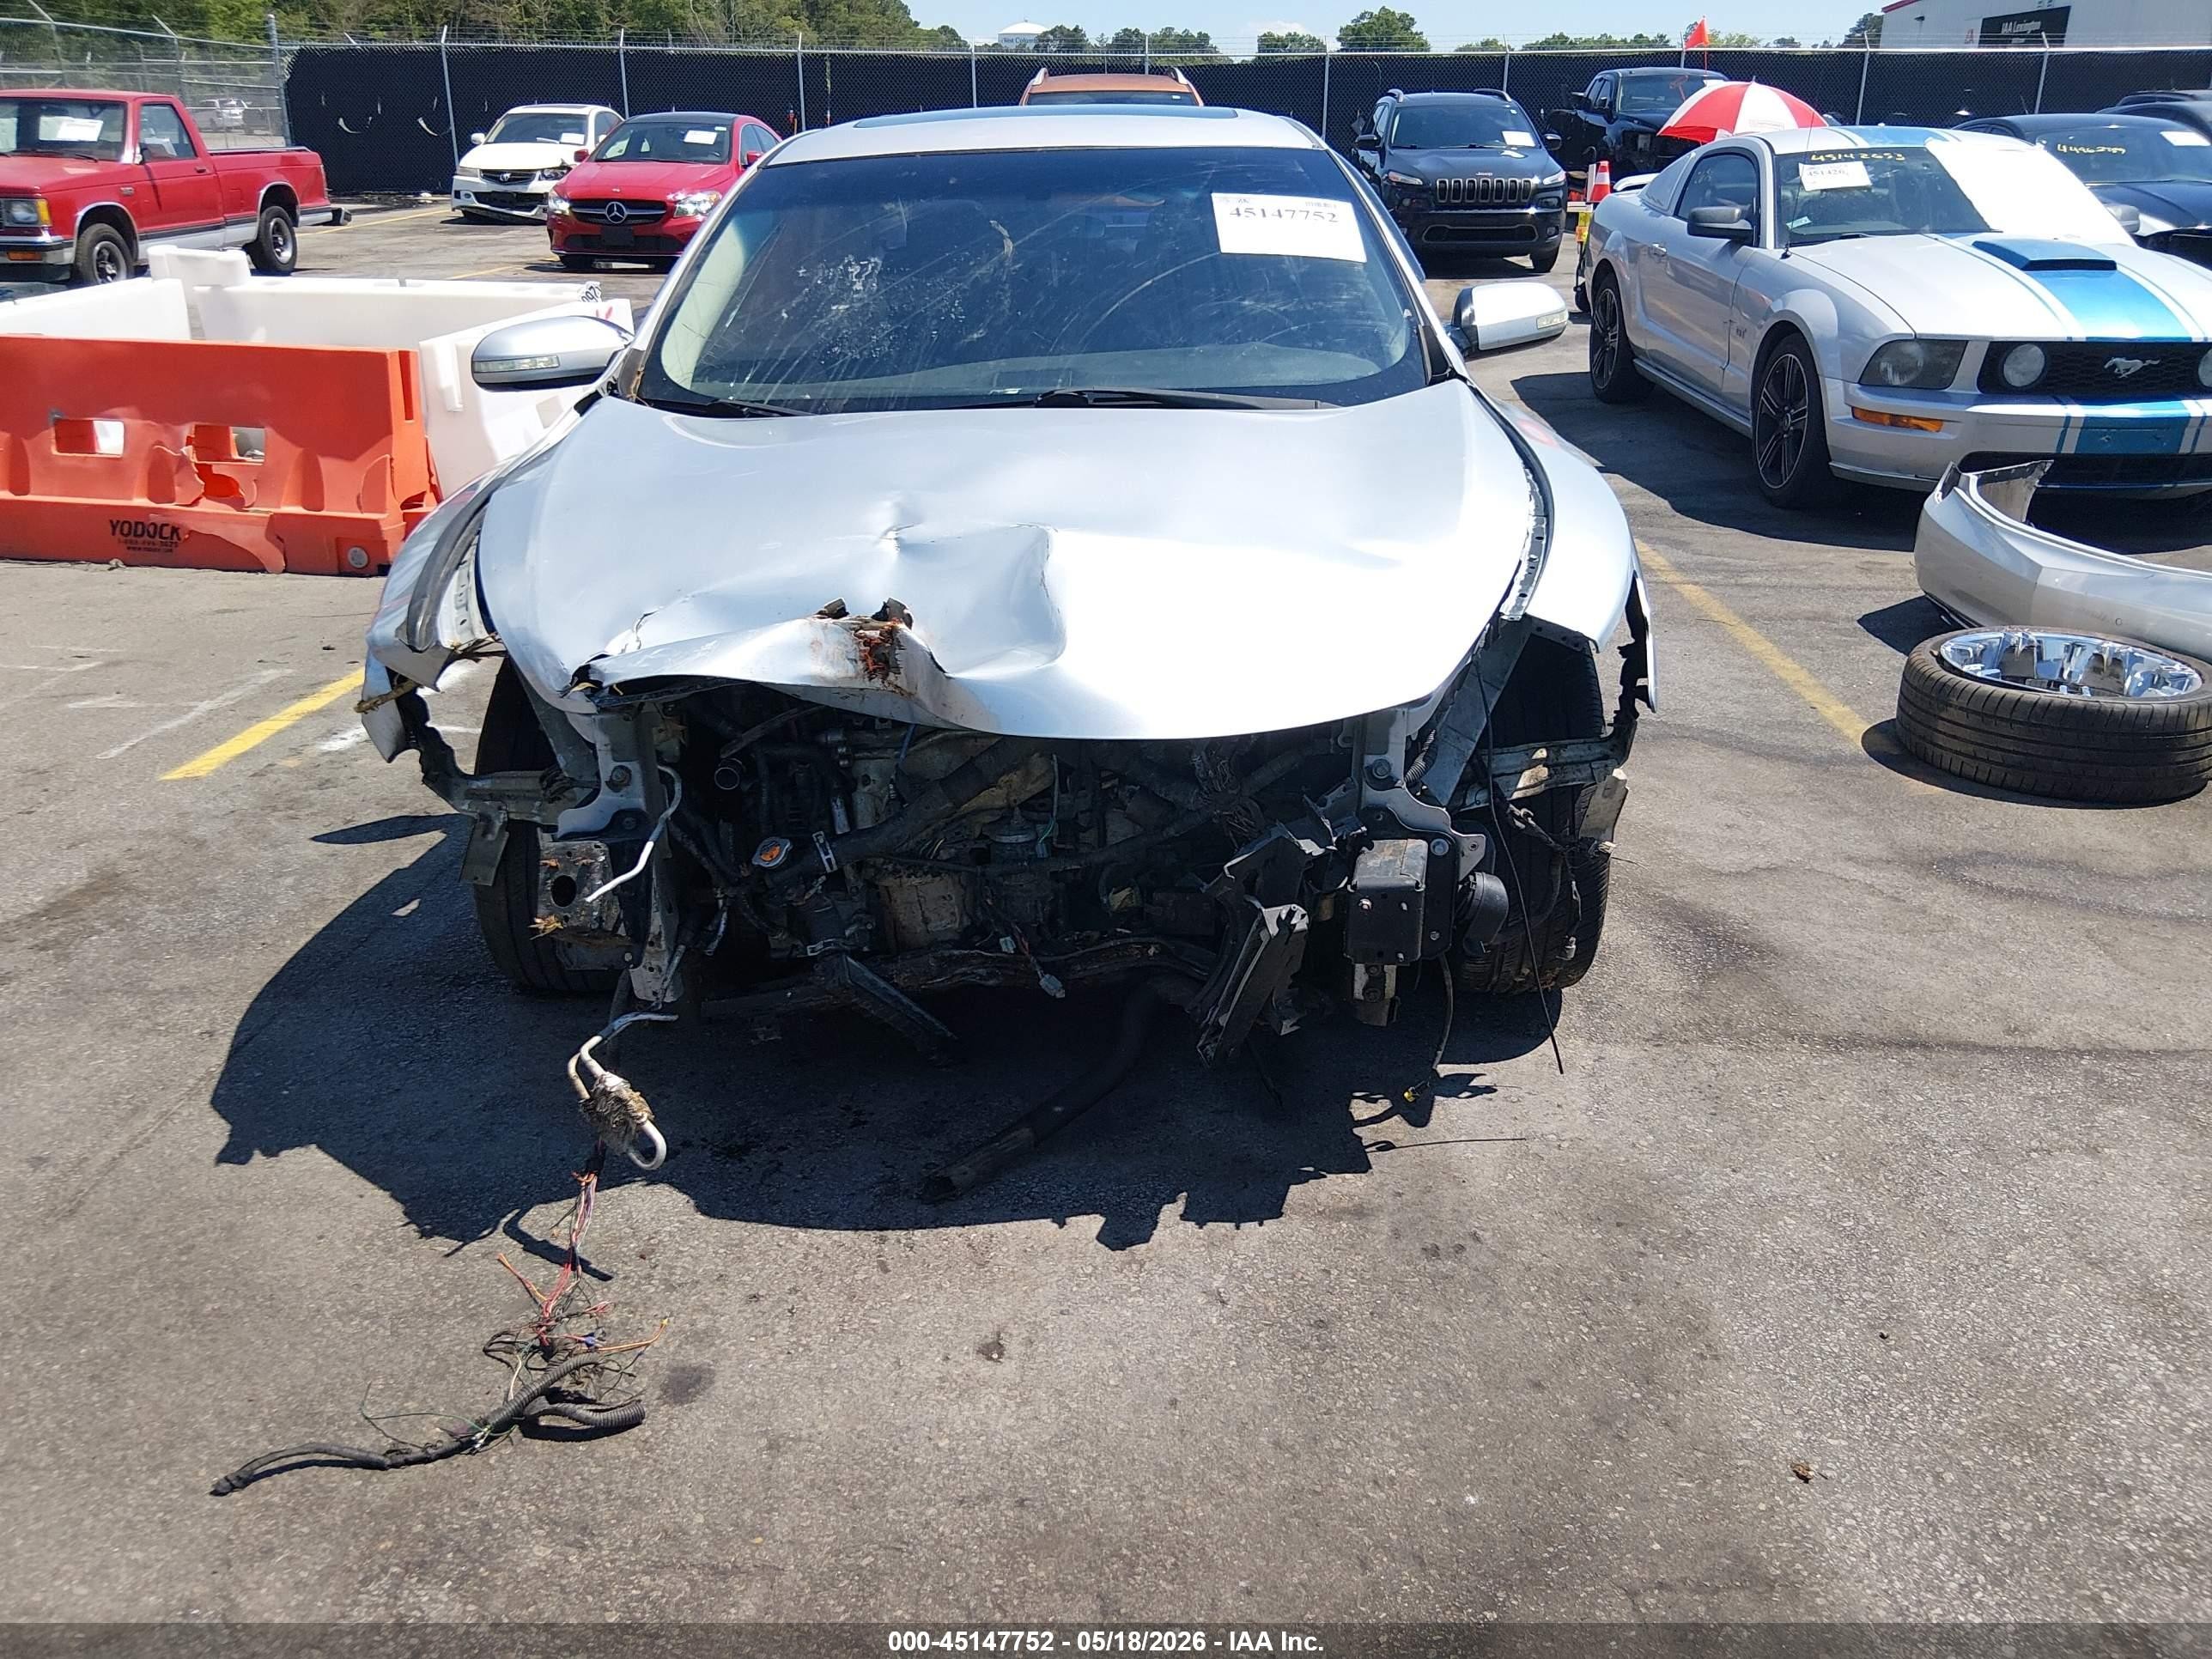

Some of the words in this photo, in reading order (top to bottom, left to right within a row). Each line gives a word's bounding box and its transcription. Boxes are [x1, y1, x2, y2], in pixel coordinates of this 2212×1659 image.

[2002, 22, 2013, 34] IAA
[1230, 207, 1340, 223] 45147752
[109, 519, 181, 542] YODOCK
